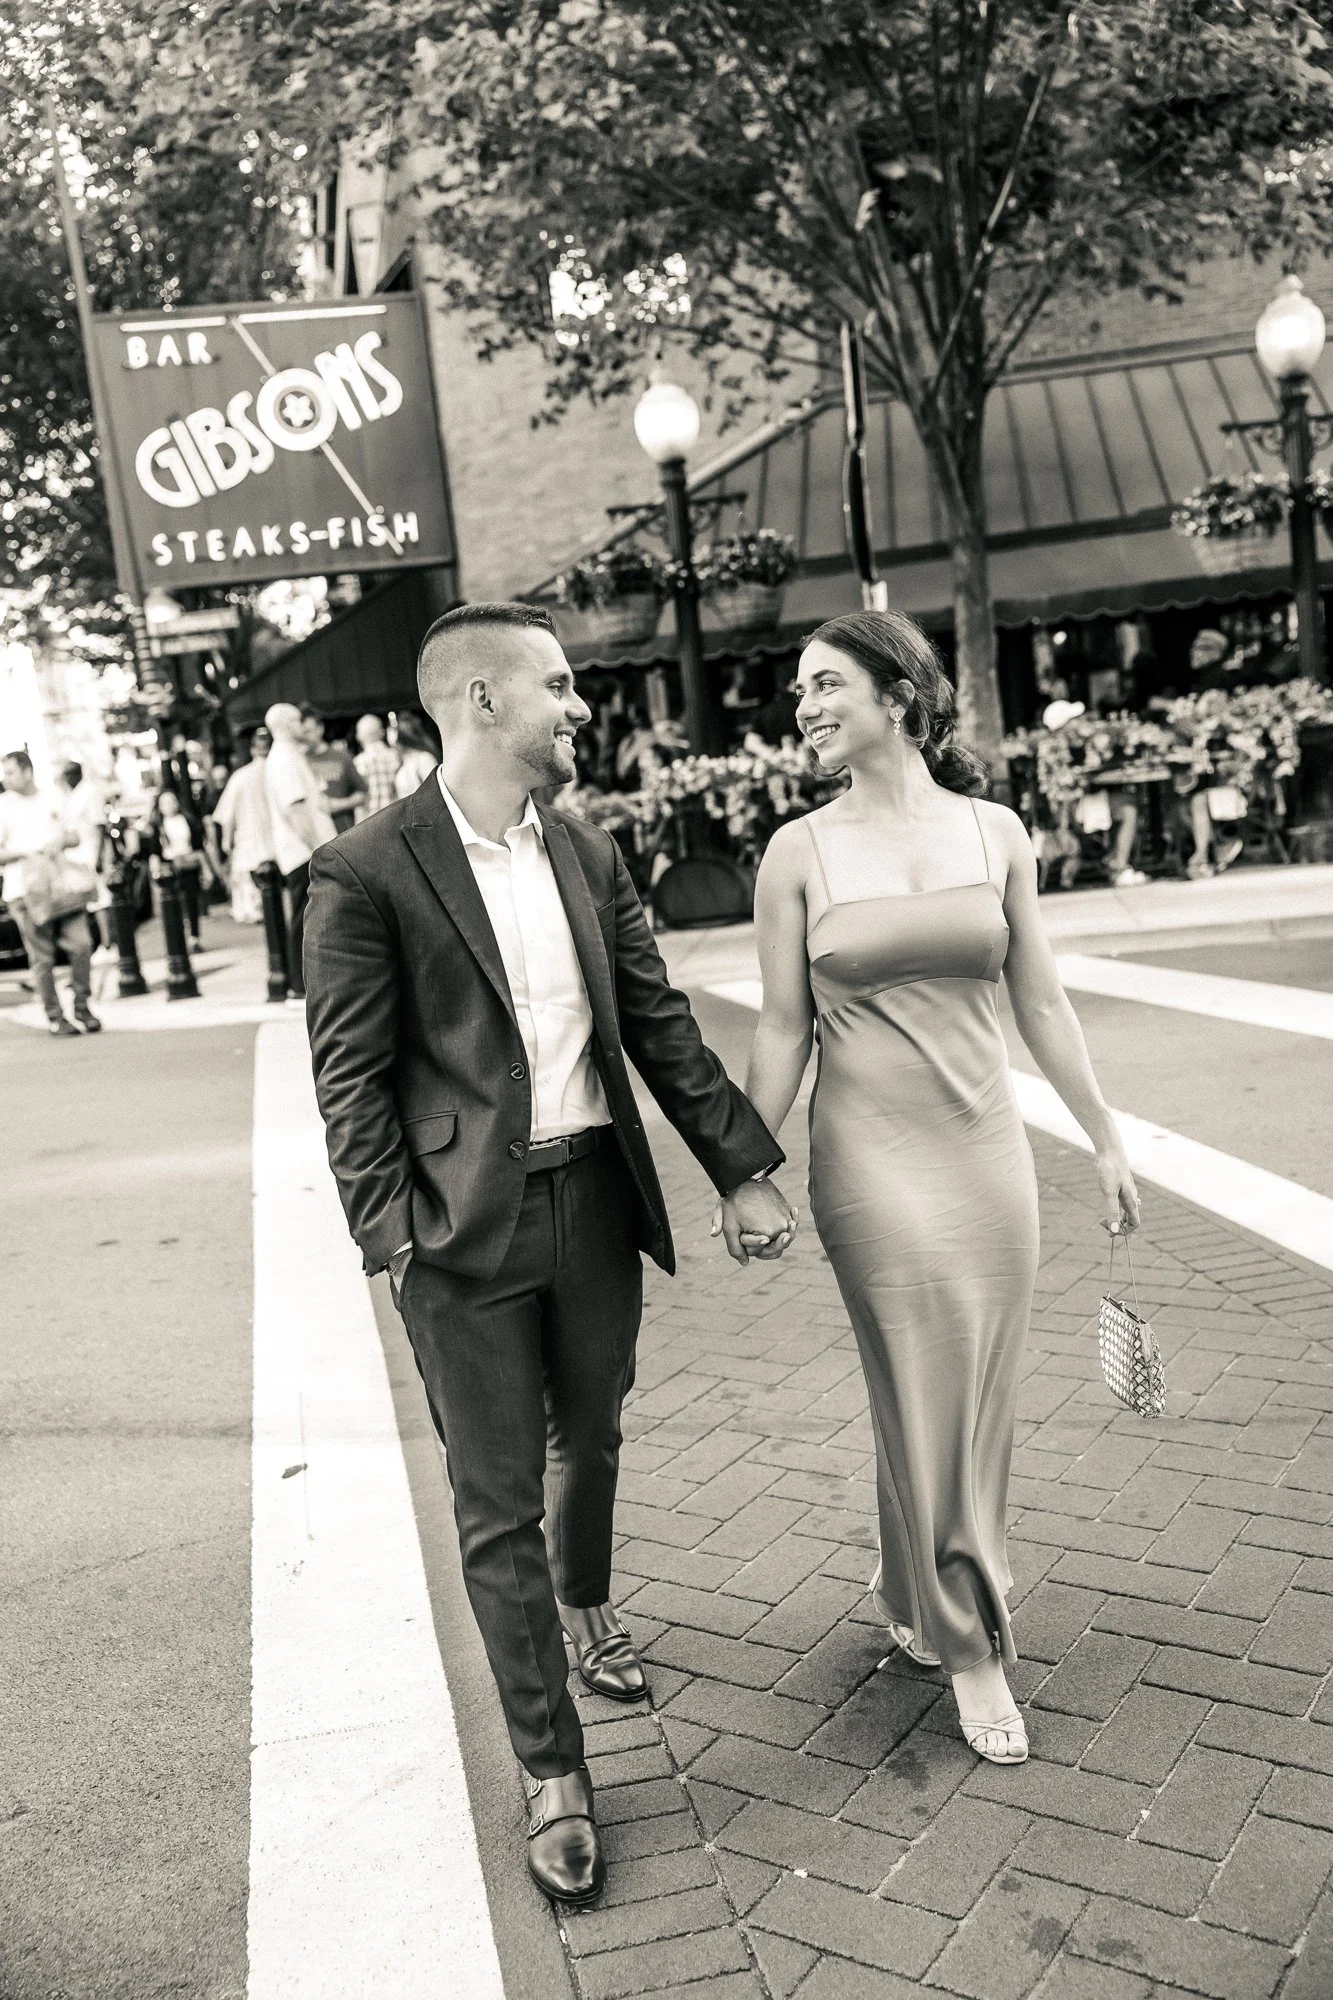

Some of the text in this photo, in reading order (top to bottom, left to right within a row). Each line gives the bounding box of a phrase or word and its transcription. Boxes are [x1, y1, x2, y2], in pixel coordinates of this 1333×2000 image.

[126, 331, 213, 369] BAR
[135, 330, 403, 508] GIBSONS
[150, 511, 420, 567] STEAKS-FISH
